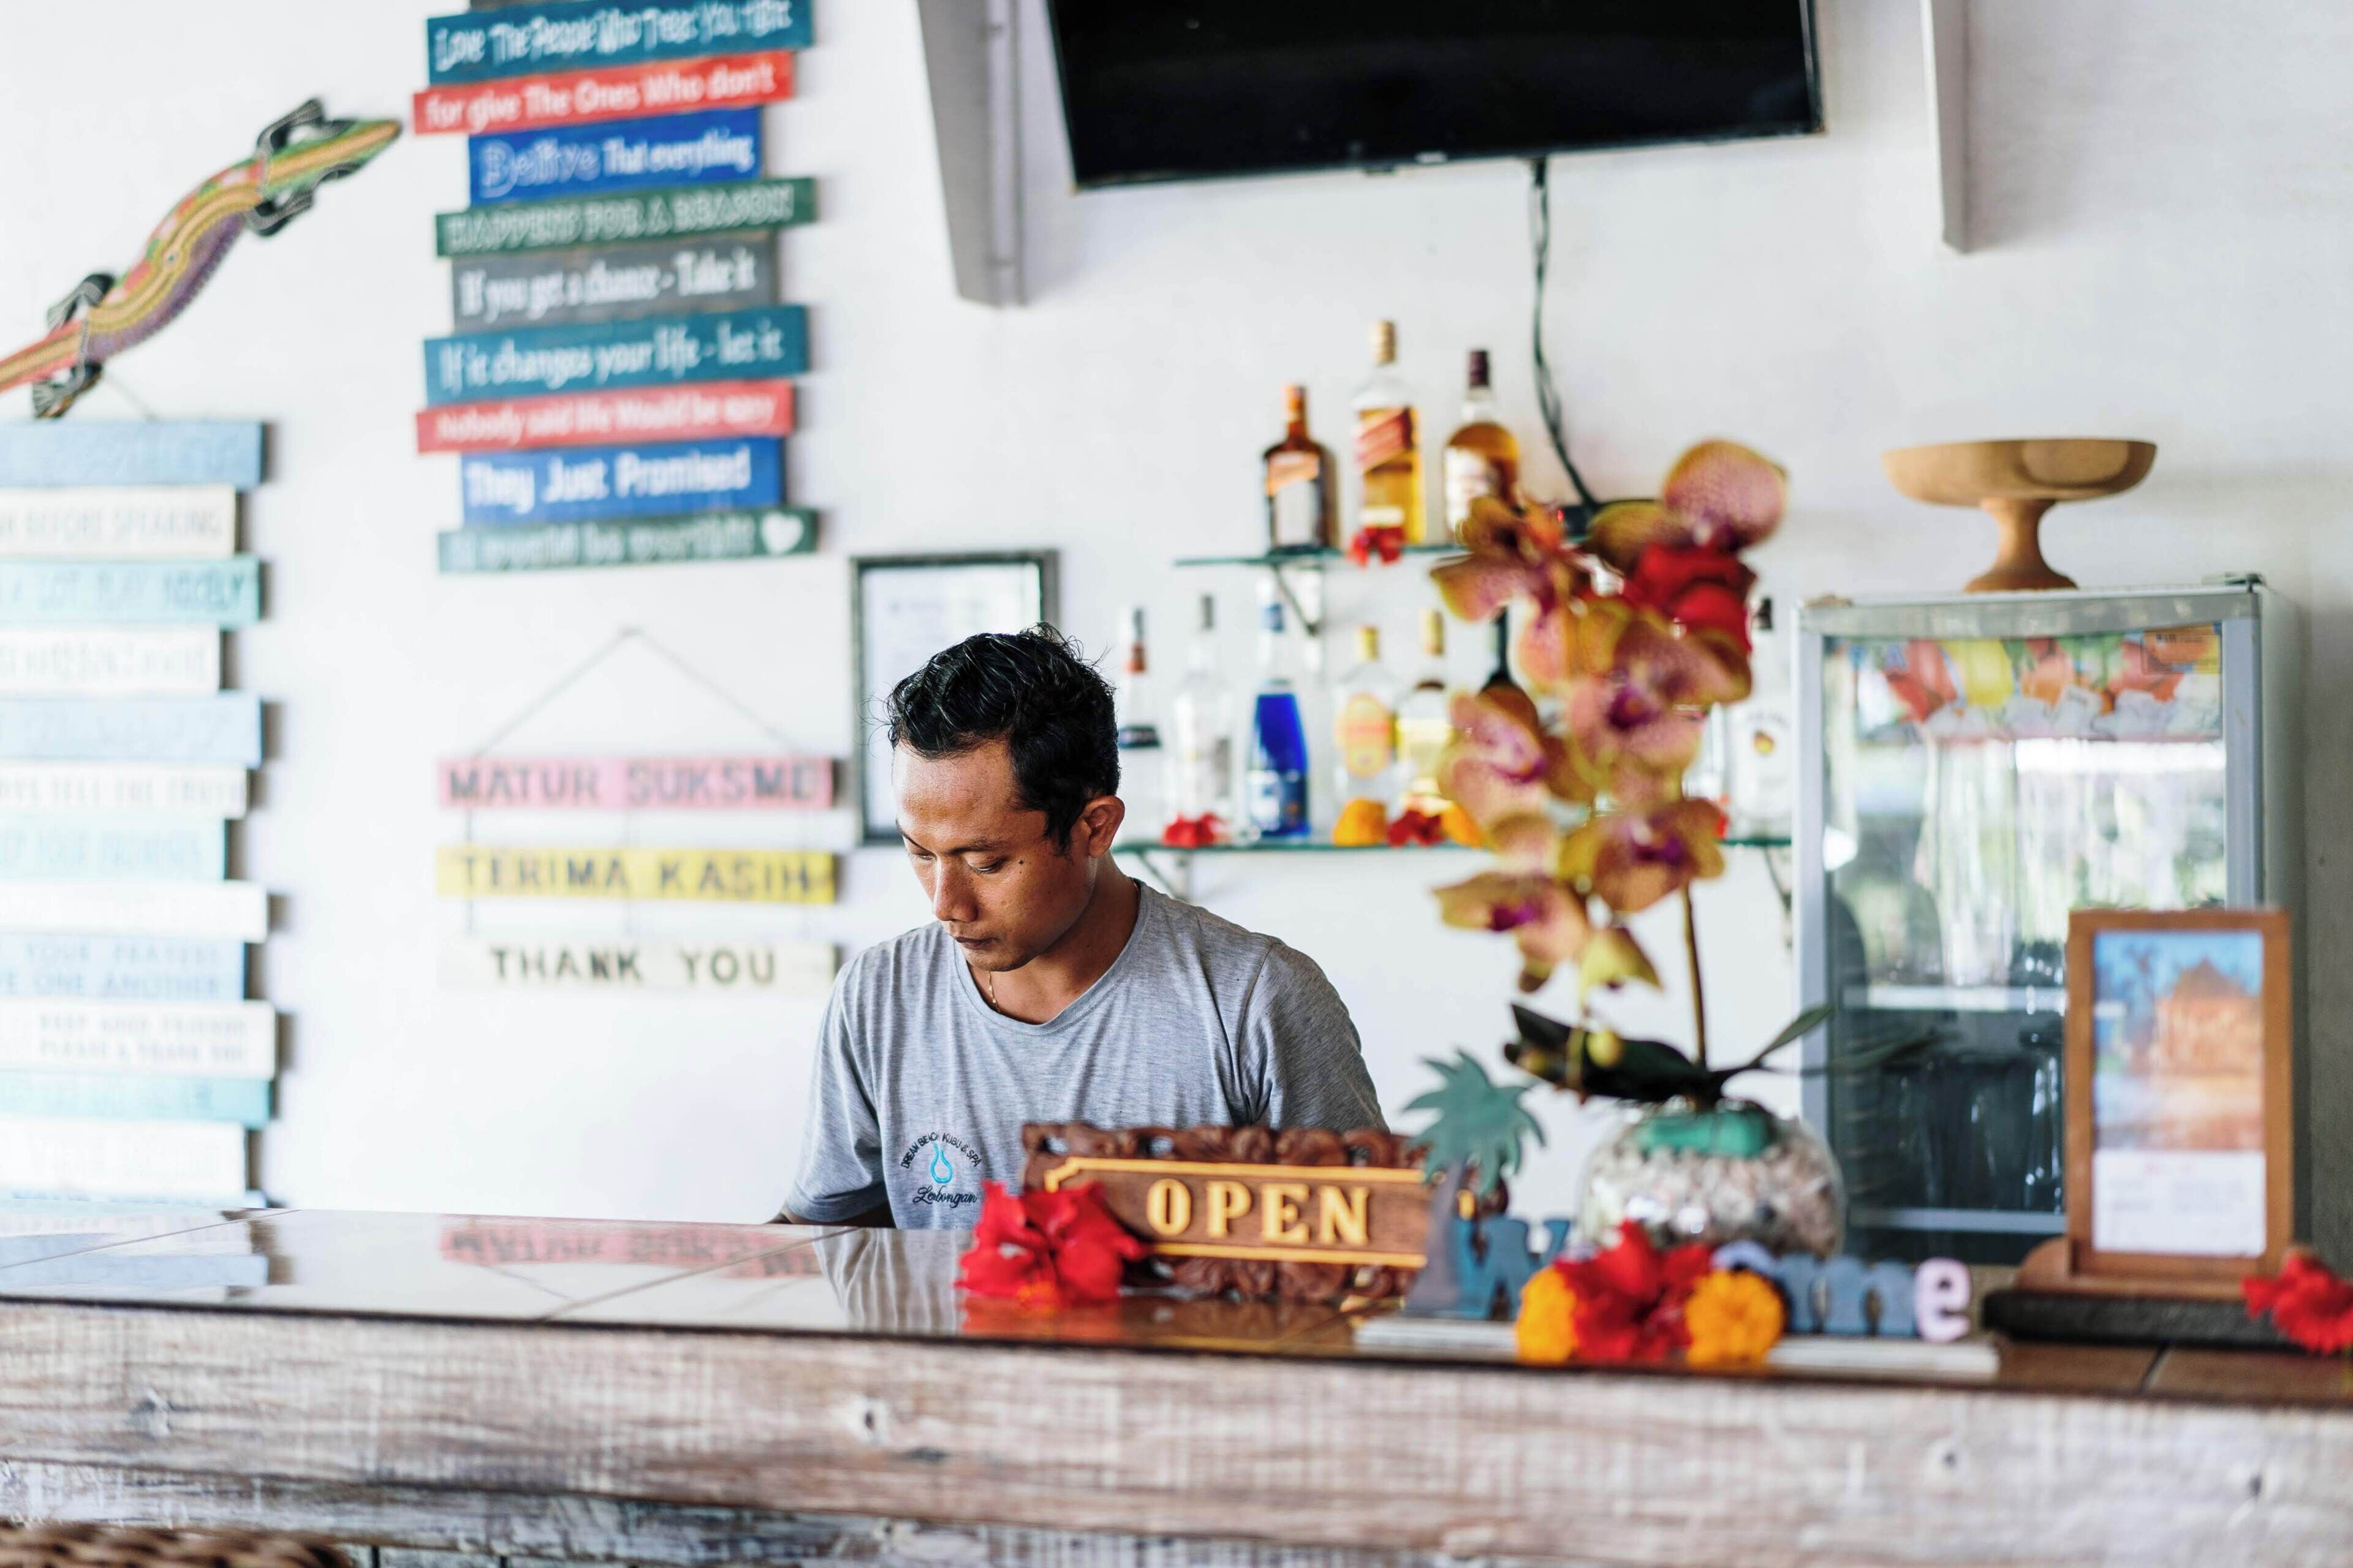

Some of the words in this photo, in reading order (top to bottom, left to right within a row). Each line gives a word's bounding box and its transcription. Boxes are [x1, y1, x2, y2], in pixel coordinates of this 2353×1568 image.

[642, 73, 704, 105] Who
[595, 342, 653, 385] your
[464, 461, 534, 515] They
[541, 454, 609, 505] Just
[449, 764, 601, 804] MATUR
[461, 854, 631, 893] TERIMA
[657, 857, 813, 895] KASIH
[488, 947, 643, 982] THANK
[680, 947, 776, 983] YOU
[901, 1143, 920, 1168] DREAM
[961, 1145, 969, 1153] &
[966, 1149, 982, 1167] SPA
[1147, 1178, 1370, 1246] OPEN
